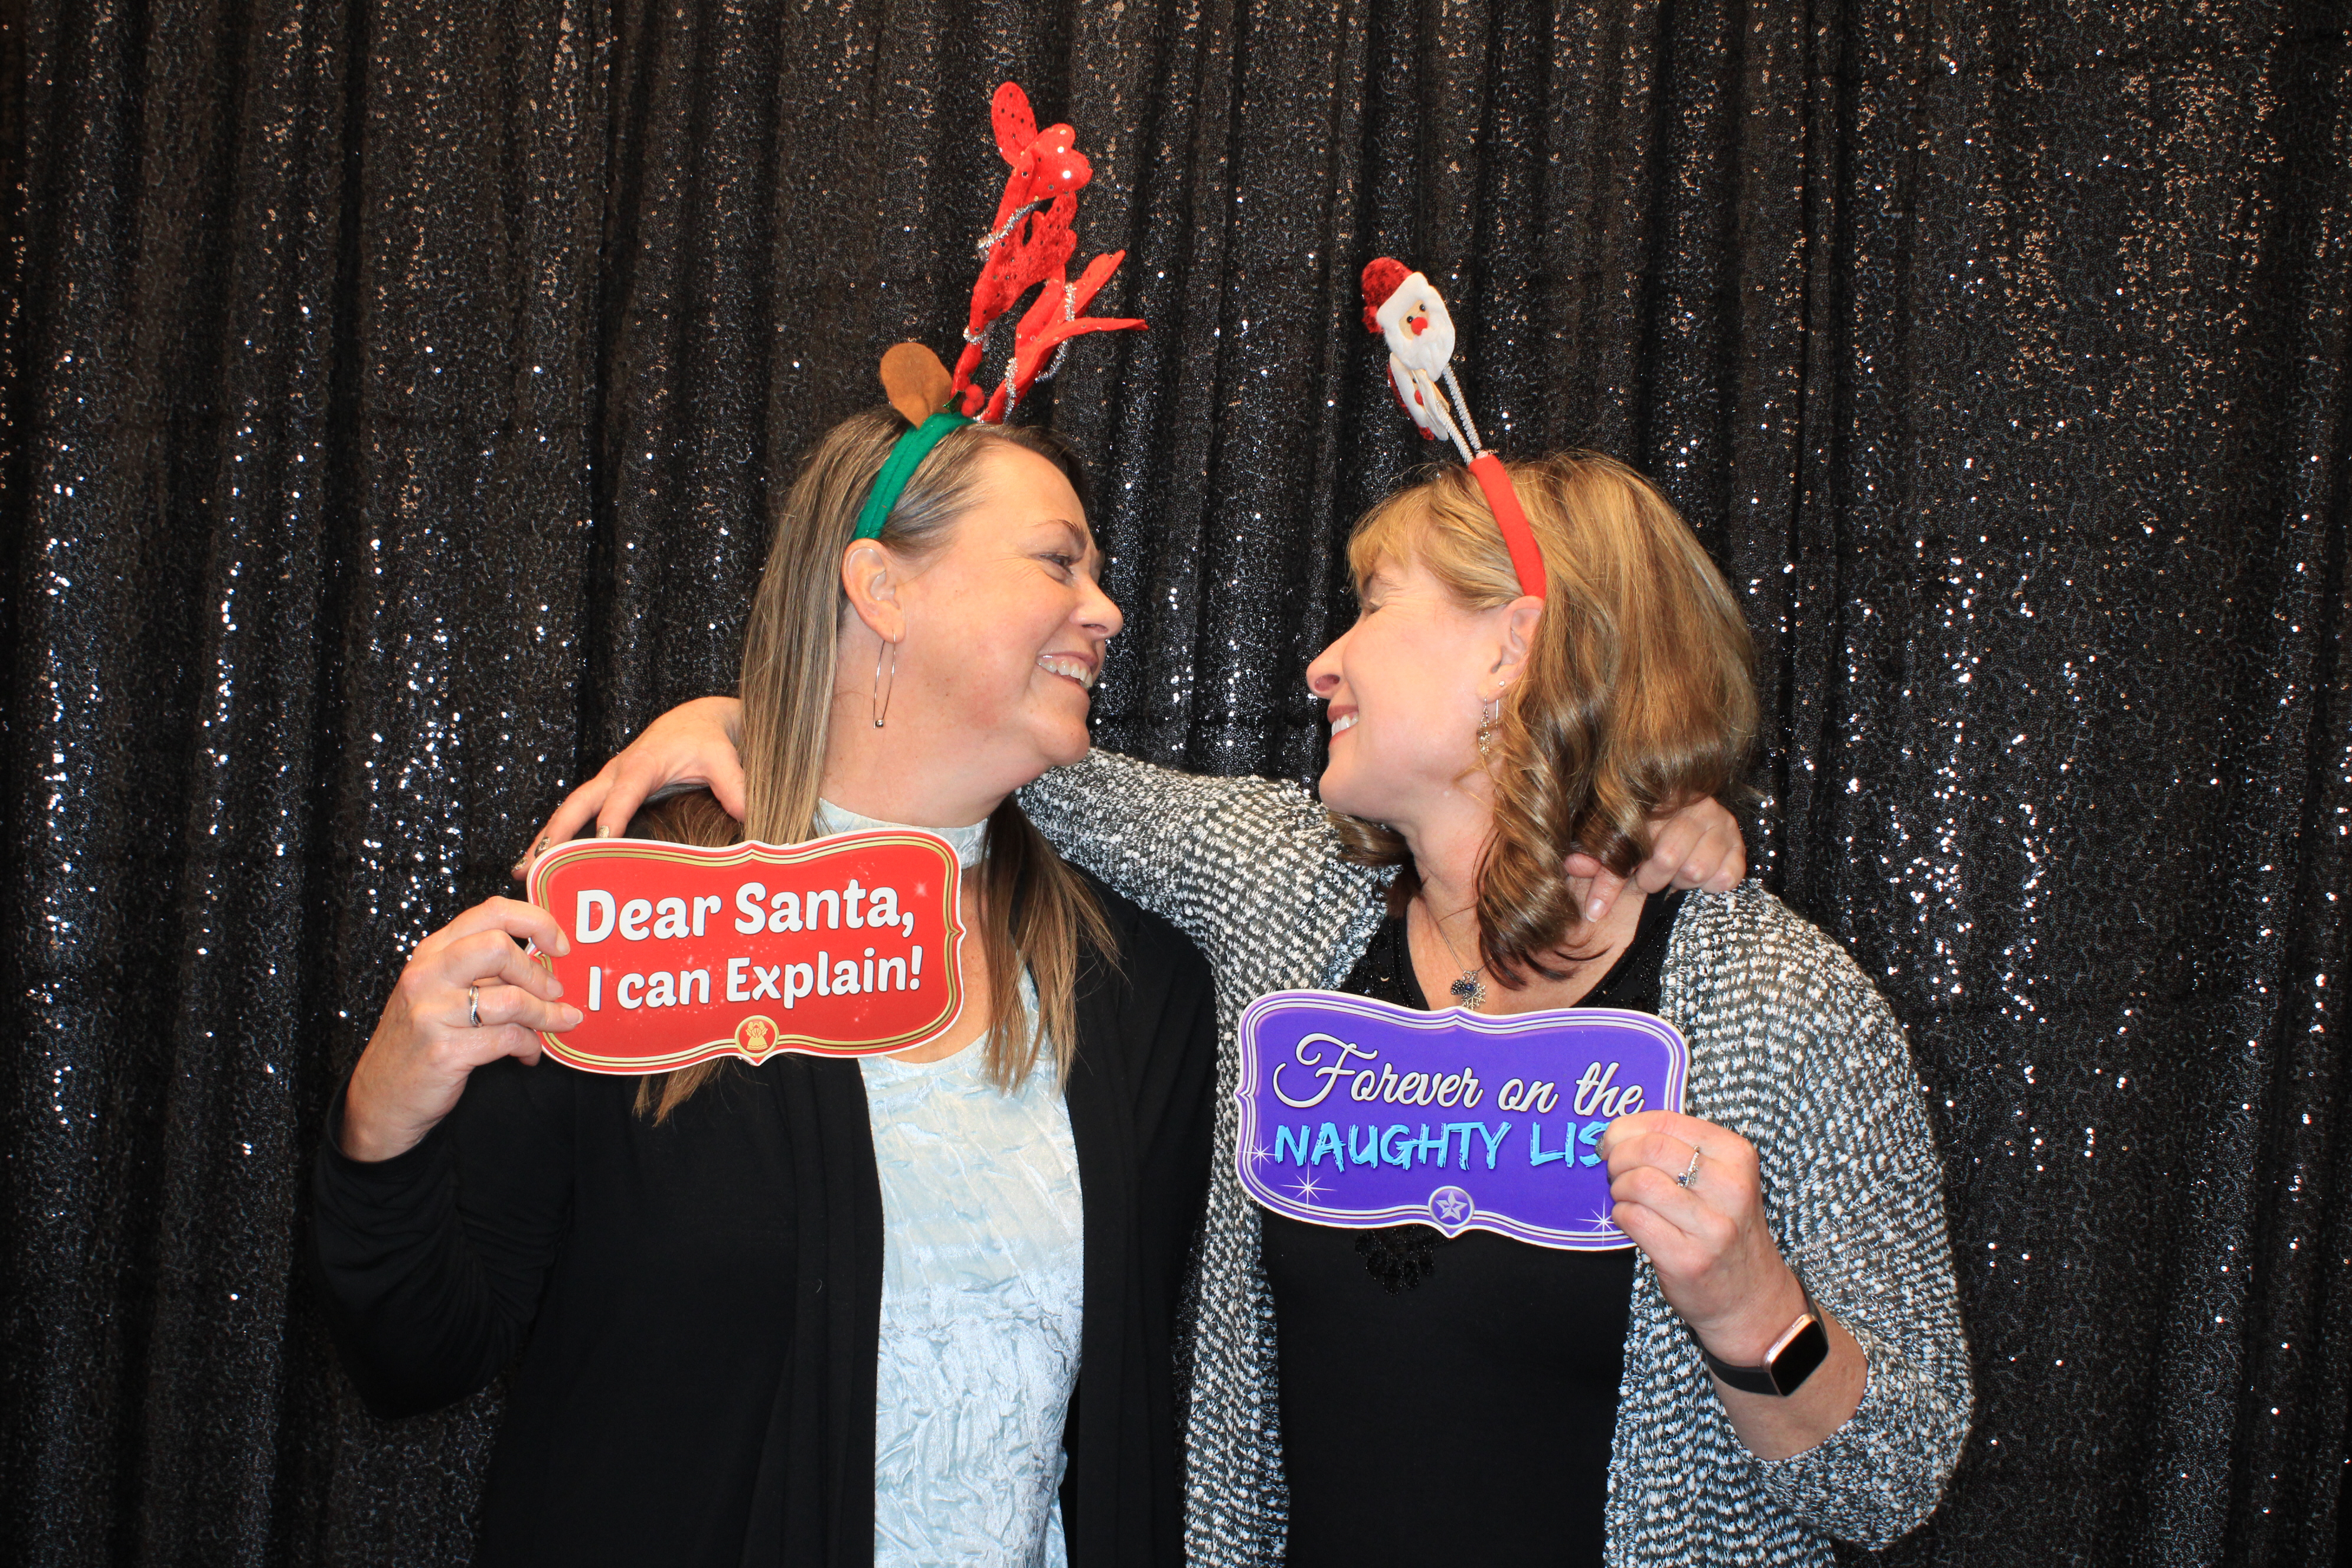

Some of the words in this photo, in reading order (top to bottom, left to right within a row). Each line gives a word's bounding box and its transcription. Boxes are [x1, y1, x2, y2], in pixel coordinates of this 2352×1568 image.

[576, 888, 722, 943] Dear
[734, 879, 914, 937] Santa,
[589, 966, 601, 1011] I
[617, 966, 709, 1010] can
[727, 946, 923, 1008] Explain!
[1273, 1033, 1484, 1108] Forever
[1498, 1078, 1559, 1113] on
[1573, 1061, 1645, 1117] the
[1274, 1122, 1511, 1171] NAUGHTY
[1530, 1121, 1611, 1168] LIS
